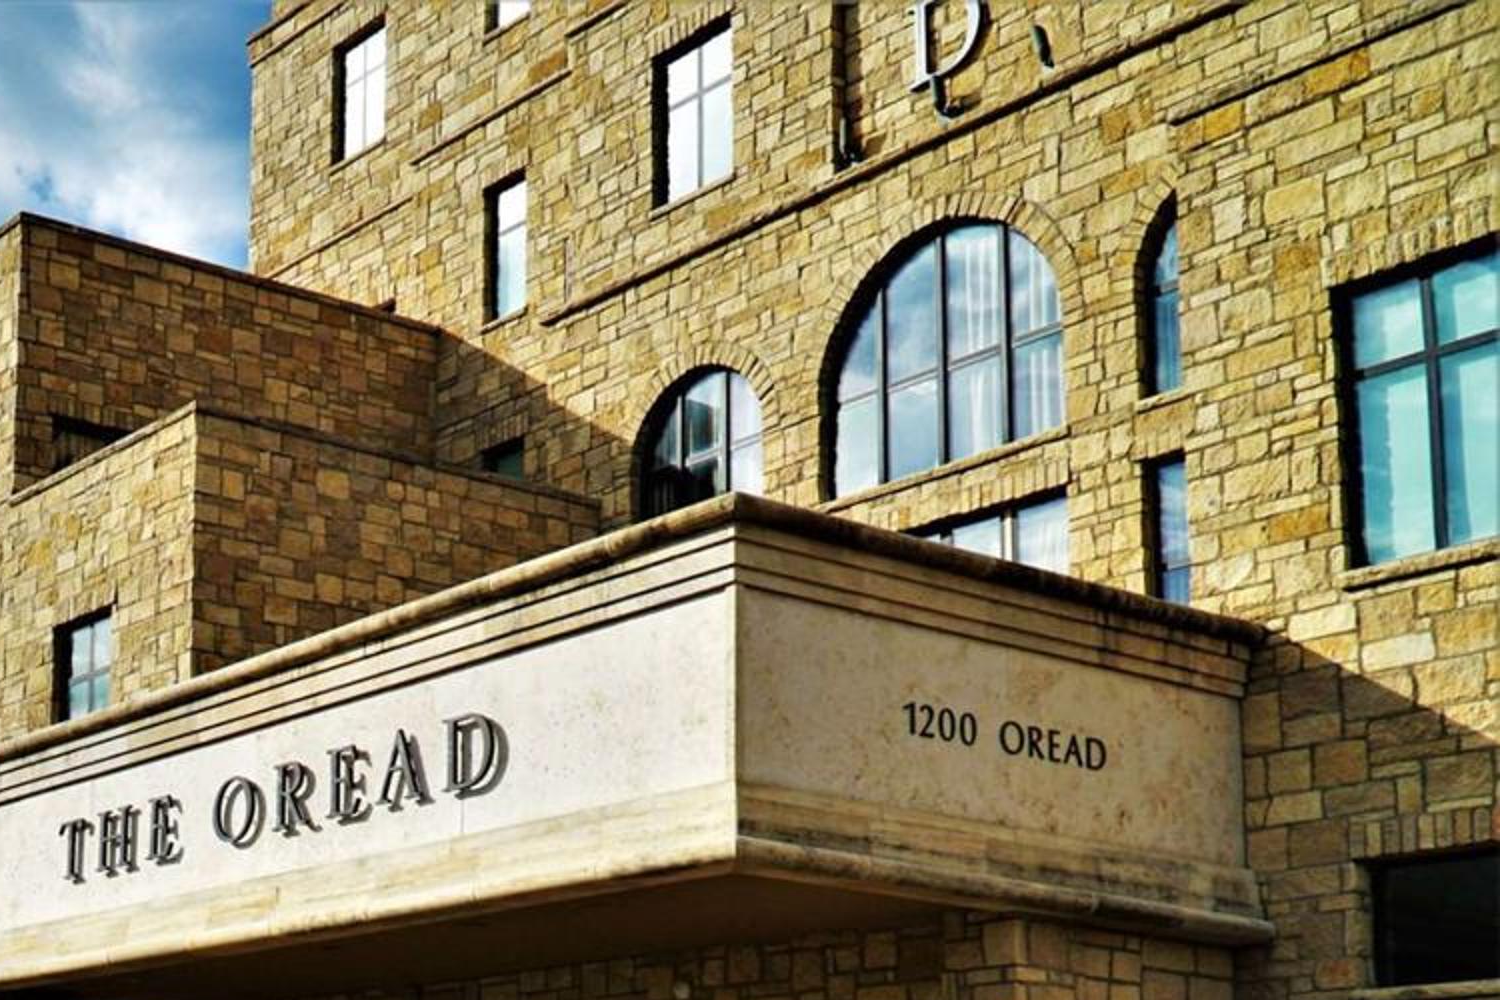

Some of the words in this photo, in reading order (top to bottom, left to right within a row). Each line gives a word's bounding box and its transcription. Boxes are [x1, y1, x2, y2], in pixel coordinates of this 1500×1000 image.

[902, 701, 977, 747] 1200
[998, 720, 1107, 771] OREAD
[58, 793, 183, 885] THE
[212, 712, 509, 850] OREAD
